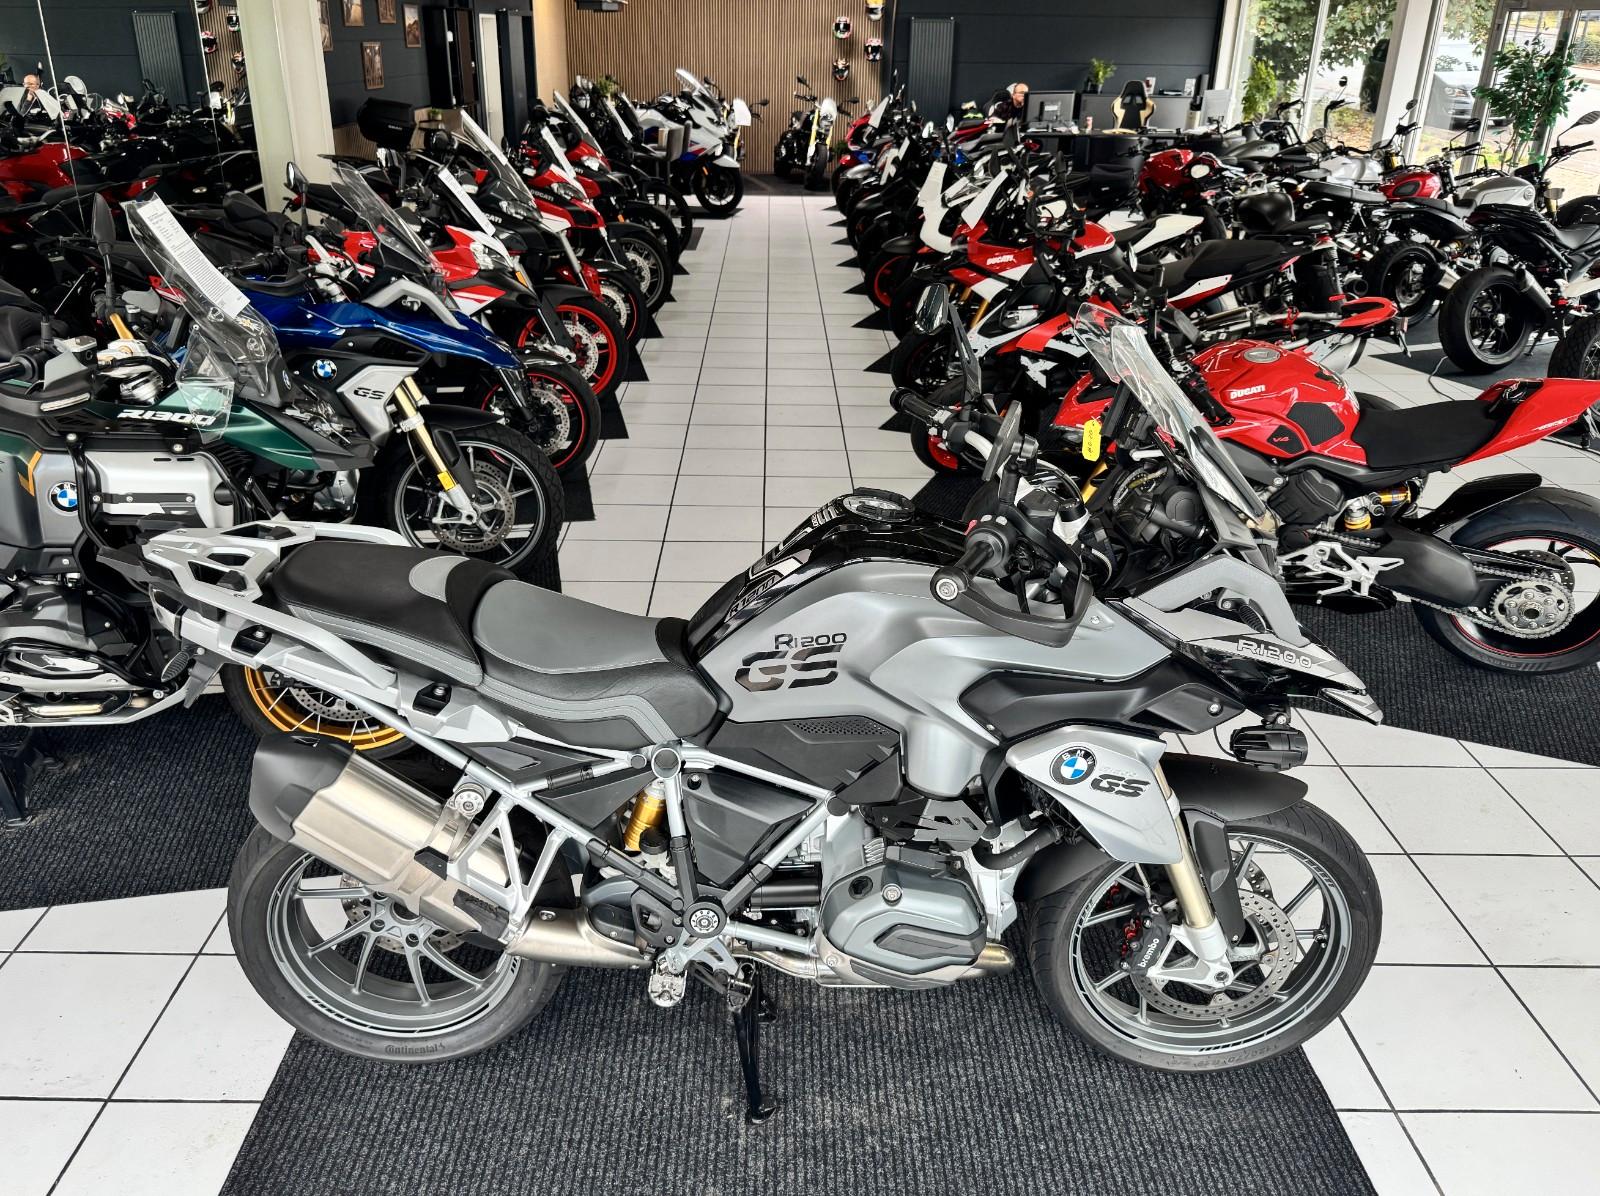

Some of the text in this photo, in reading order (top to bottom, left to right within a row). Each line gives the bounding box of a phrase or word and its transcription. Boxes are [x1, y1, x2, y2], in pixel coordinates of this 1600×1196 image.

[530, 189, 554, 202] DUCATI
[986, 254, 1014, 265] DUCATI
[353, 387, 386, 400] GS
[1230, 384, 1266, 400] DUCATI
[774, 632, 847, 650] R1200
[1237, 639, 1312, 669] R1200
[735, 644, 844, 693] GS
[1090, 773, 1151, 798] GS
[1137, 938, 1160, 968] brembo
[384, 1043, 438, 1055] Continental
